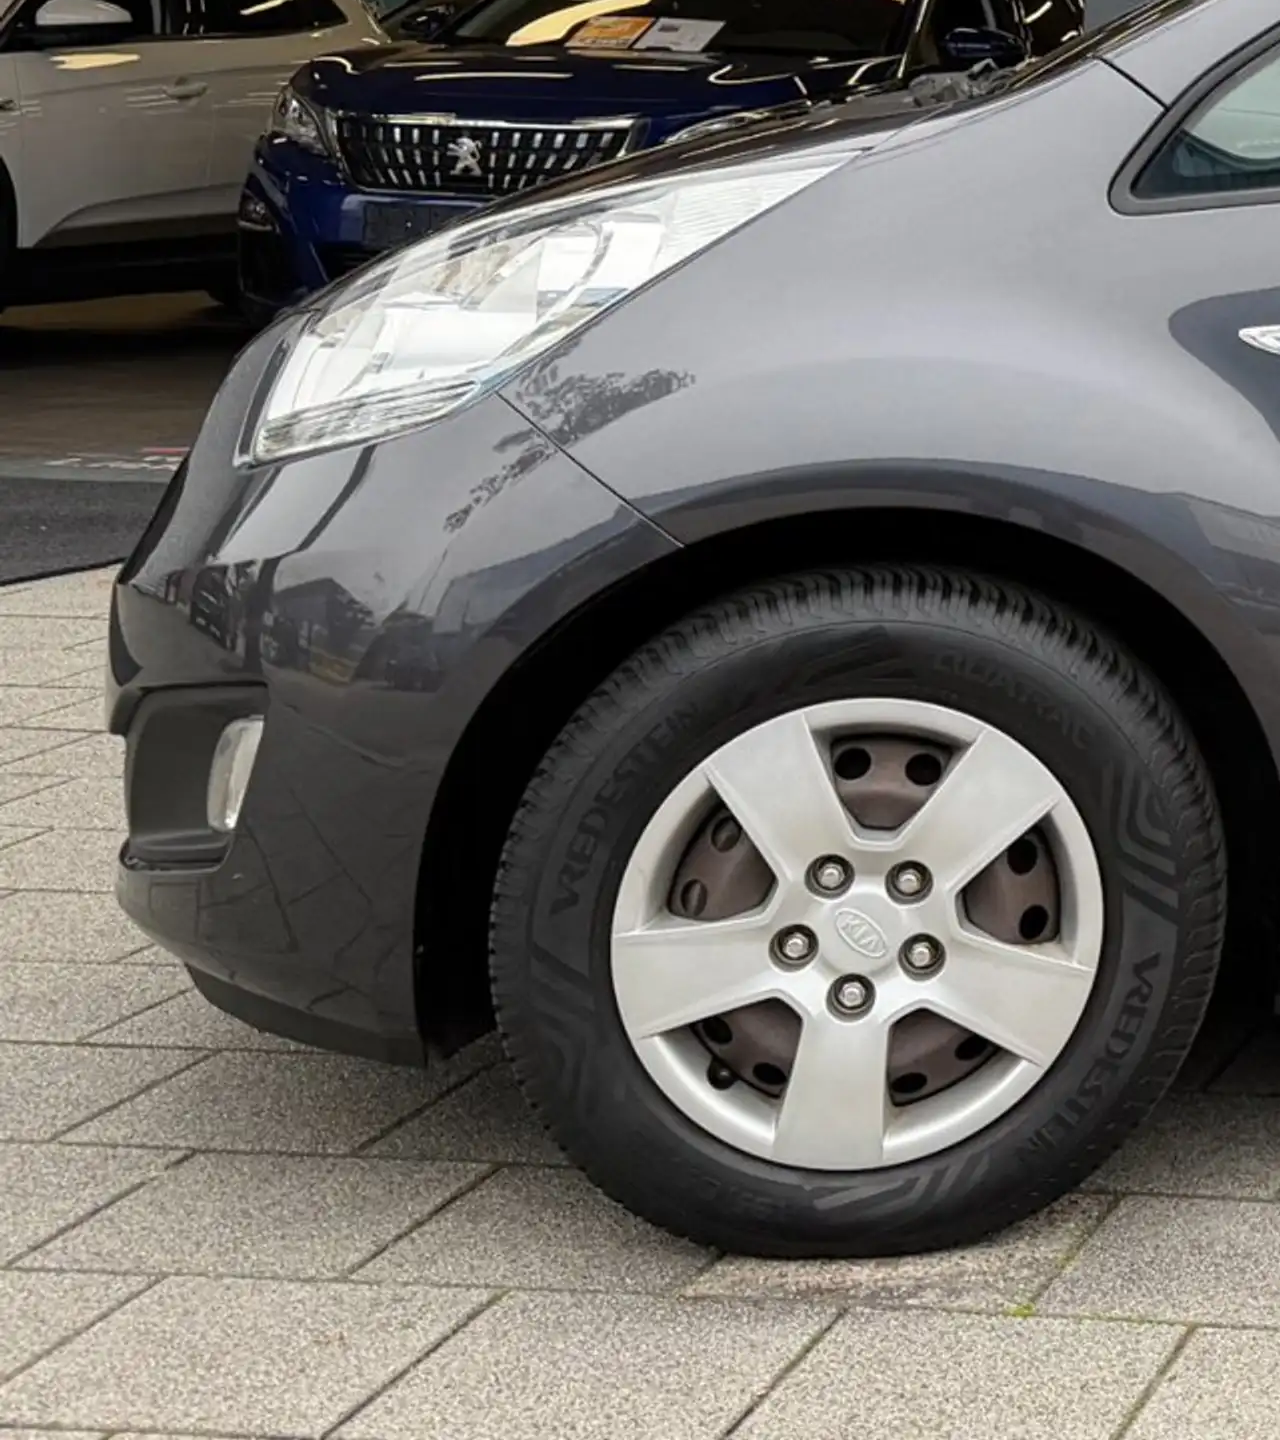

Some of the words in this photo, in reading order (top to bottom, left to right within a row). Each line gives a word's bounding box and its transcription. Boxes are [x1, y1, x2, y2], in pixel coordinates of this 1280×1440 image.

[550, 701, 702, 916] VREDESTEIN
[839, 913, 884, 955] KIA
[1008, 952, 1161, 1166] VREDESTEIN
